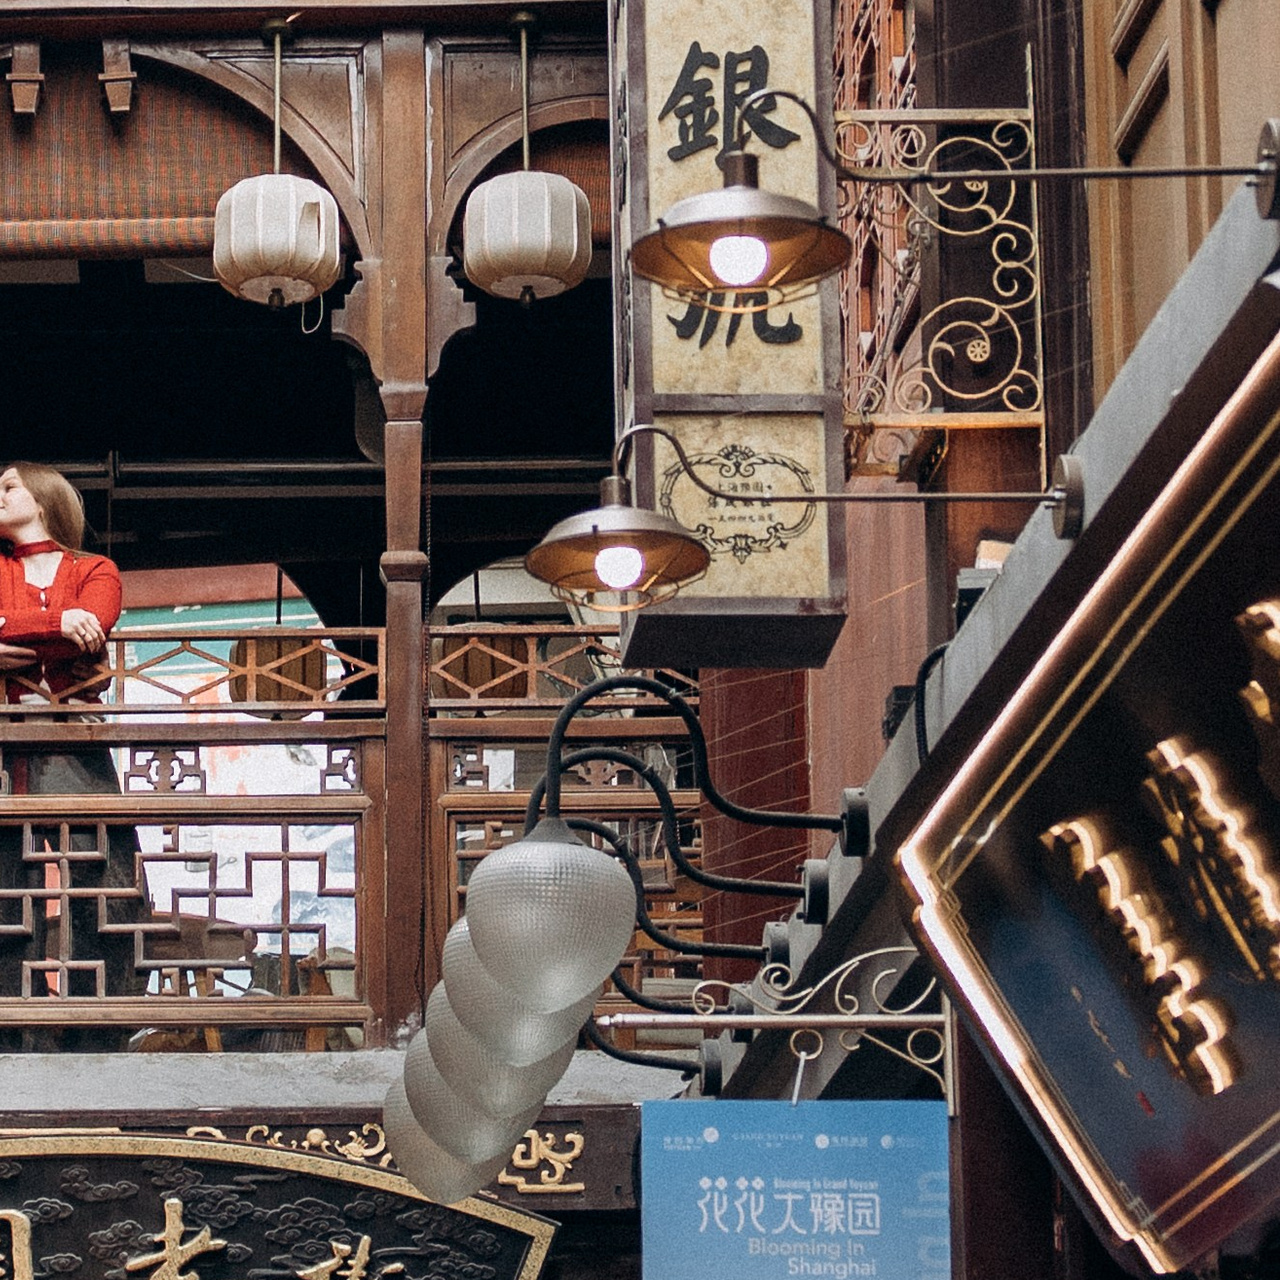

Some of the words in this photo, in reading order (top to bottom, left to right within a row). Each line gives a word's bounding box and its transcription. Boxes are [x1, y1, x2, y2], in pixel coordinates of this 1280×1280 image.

[748, 1238, 841, 1259] Blooming
[847, 1238, 865, 1255] In
[787, 1257, 876, 1280] Shanghai
